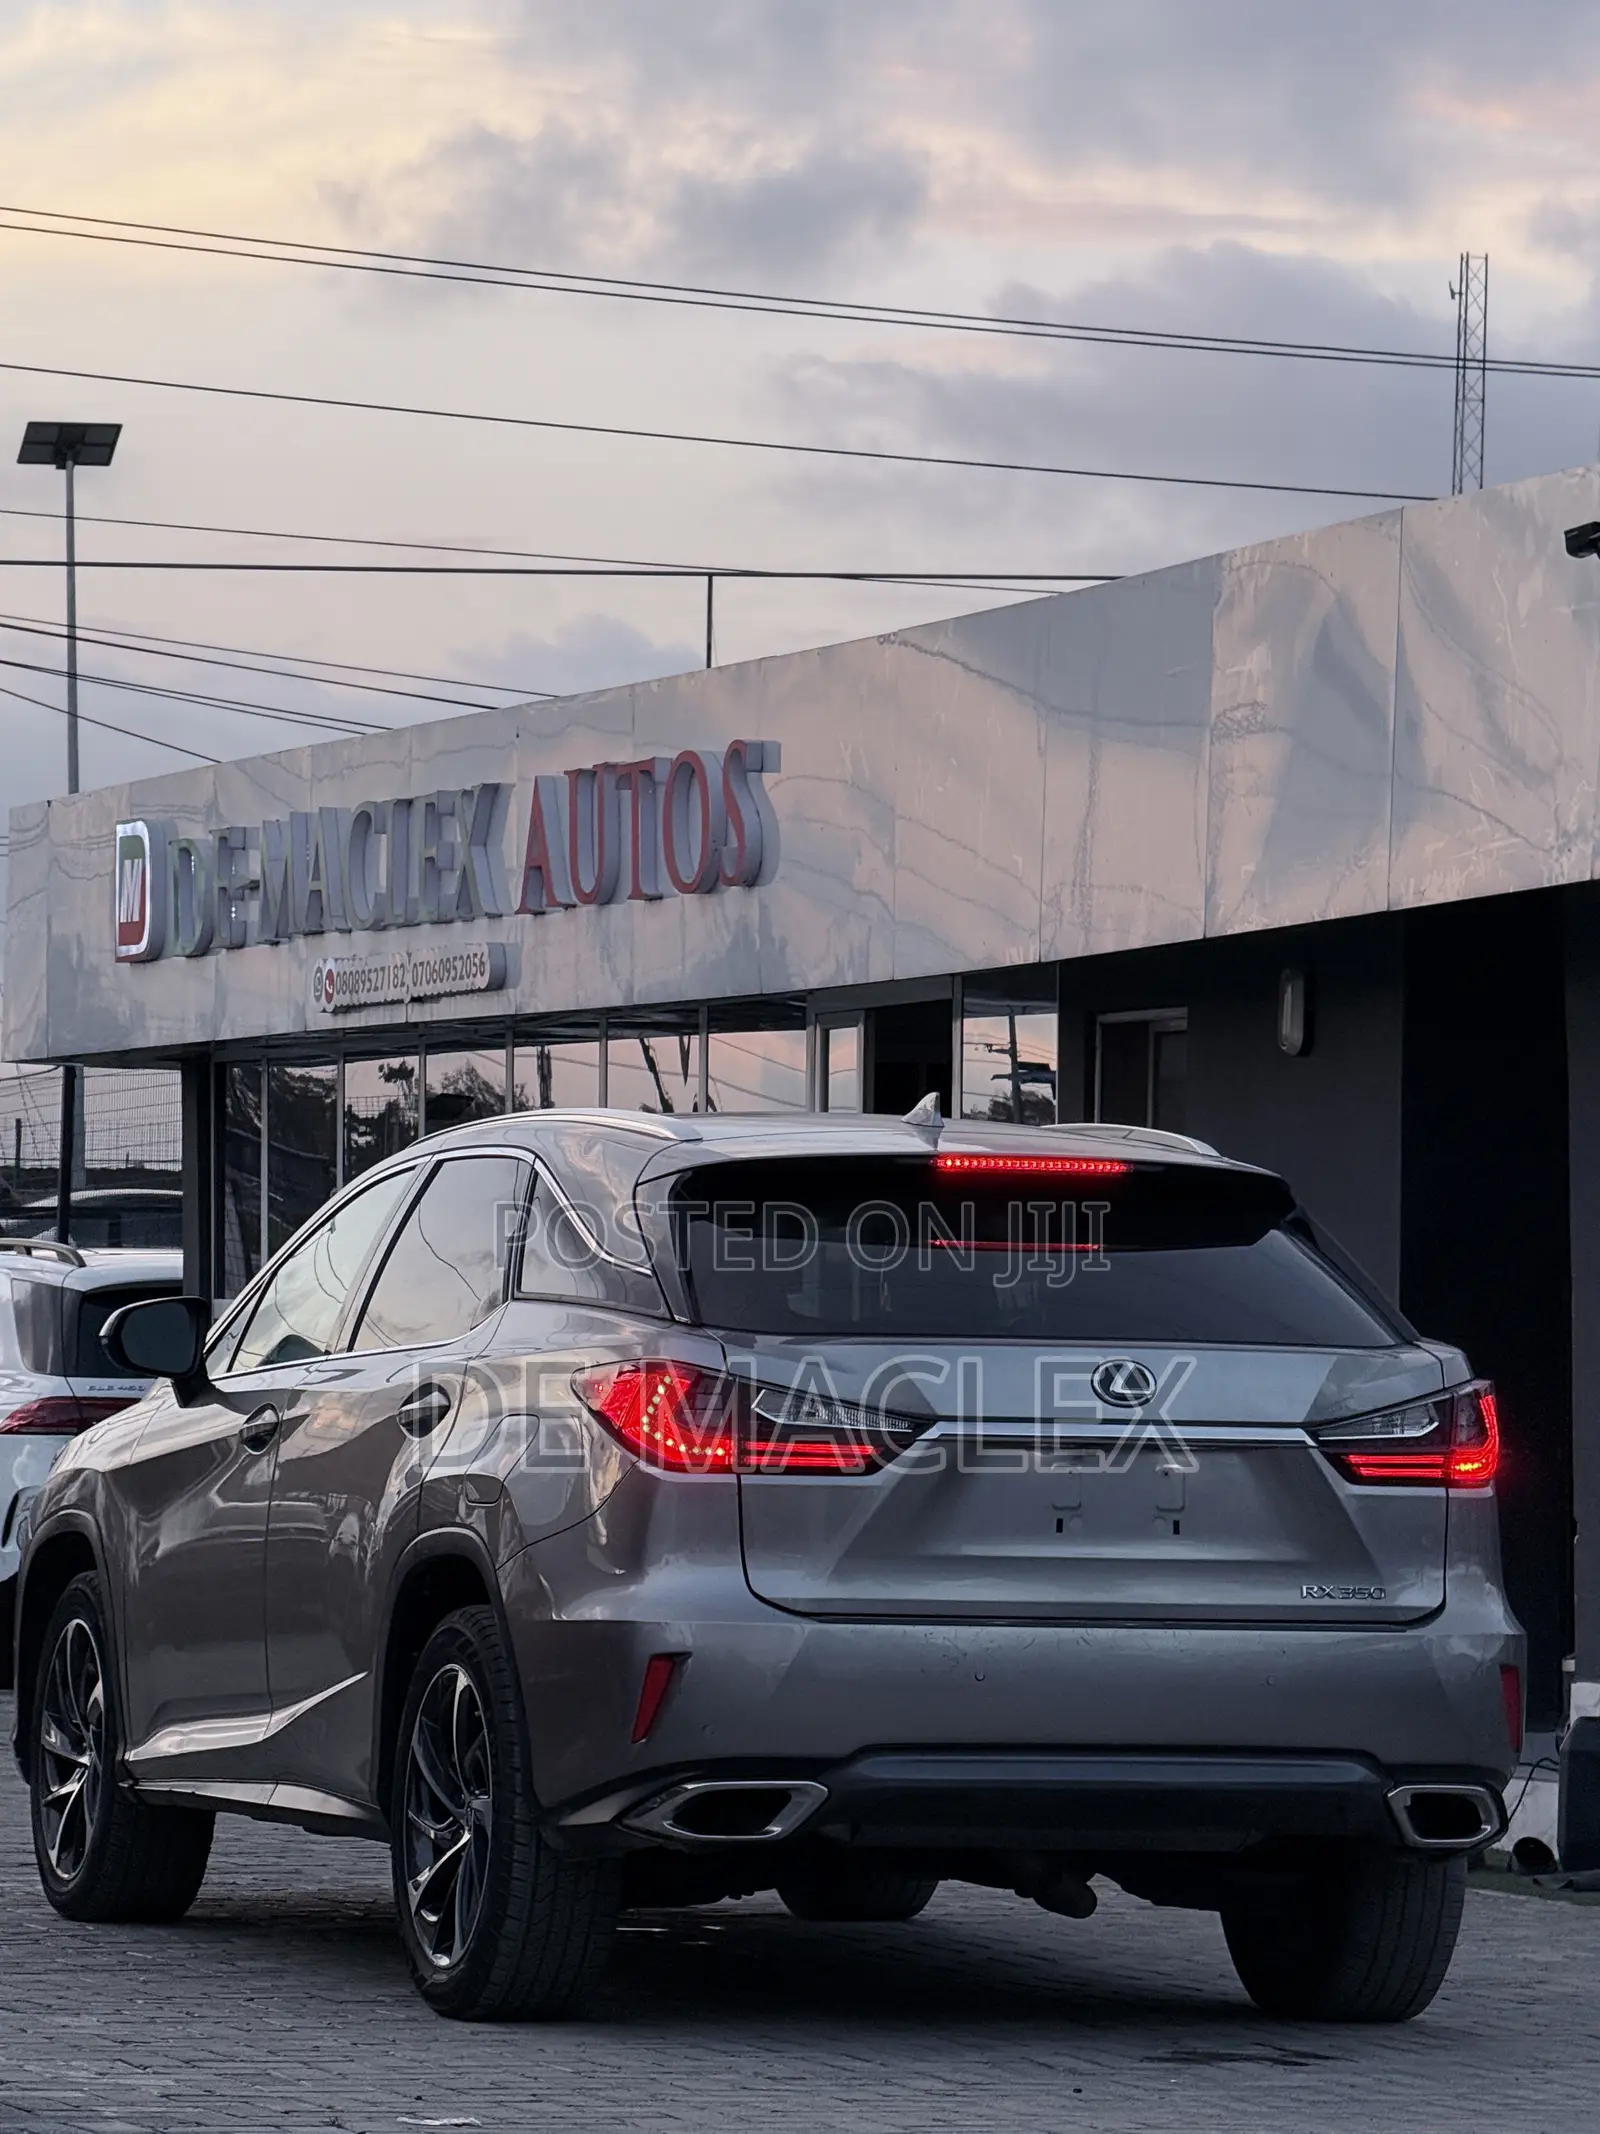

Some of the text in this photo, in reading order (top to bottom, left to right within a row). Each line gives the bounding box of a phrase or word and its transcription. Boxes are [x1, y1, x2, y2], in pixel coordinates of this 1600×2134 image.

[515, 739, 781, 915] AUTOS
[1301, 1585, 1386, 1600] RX 350
